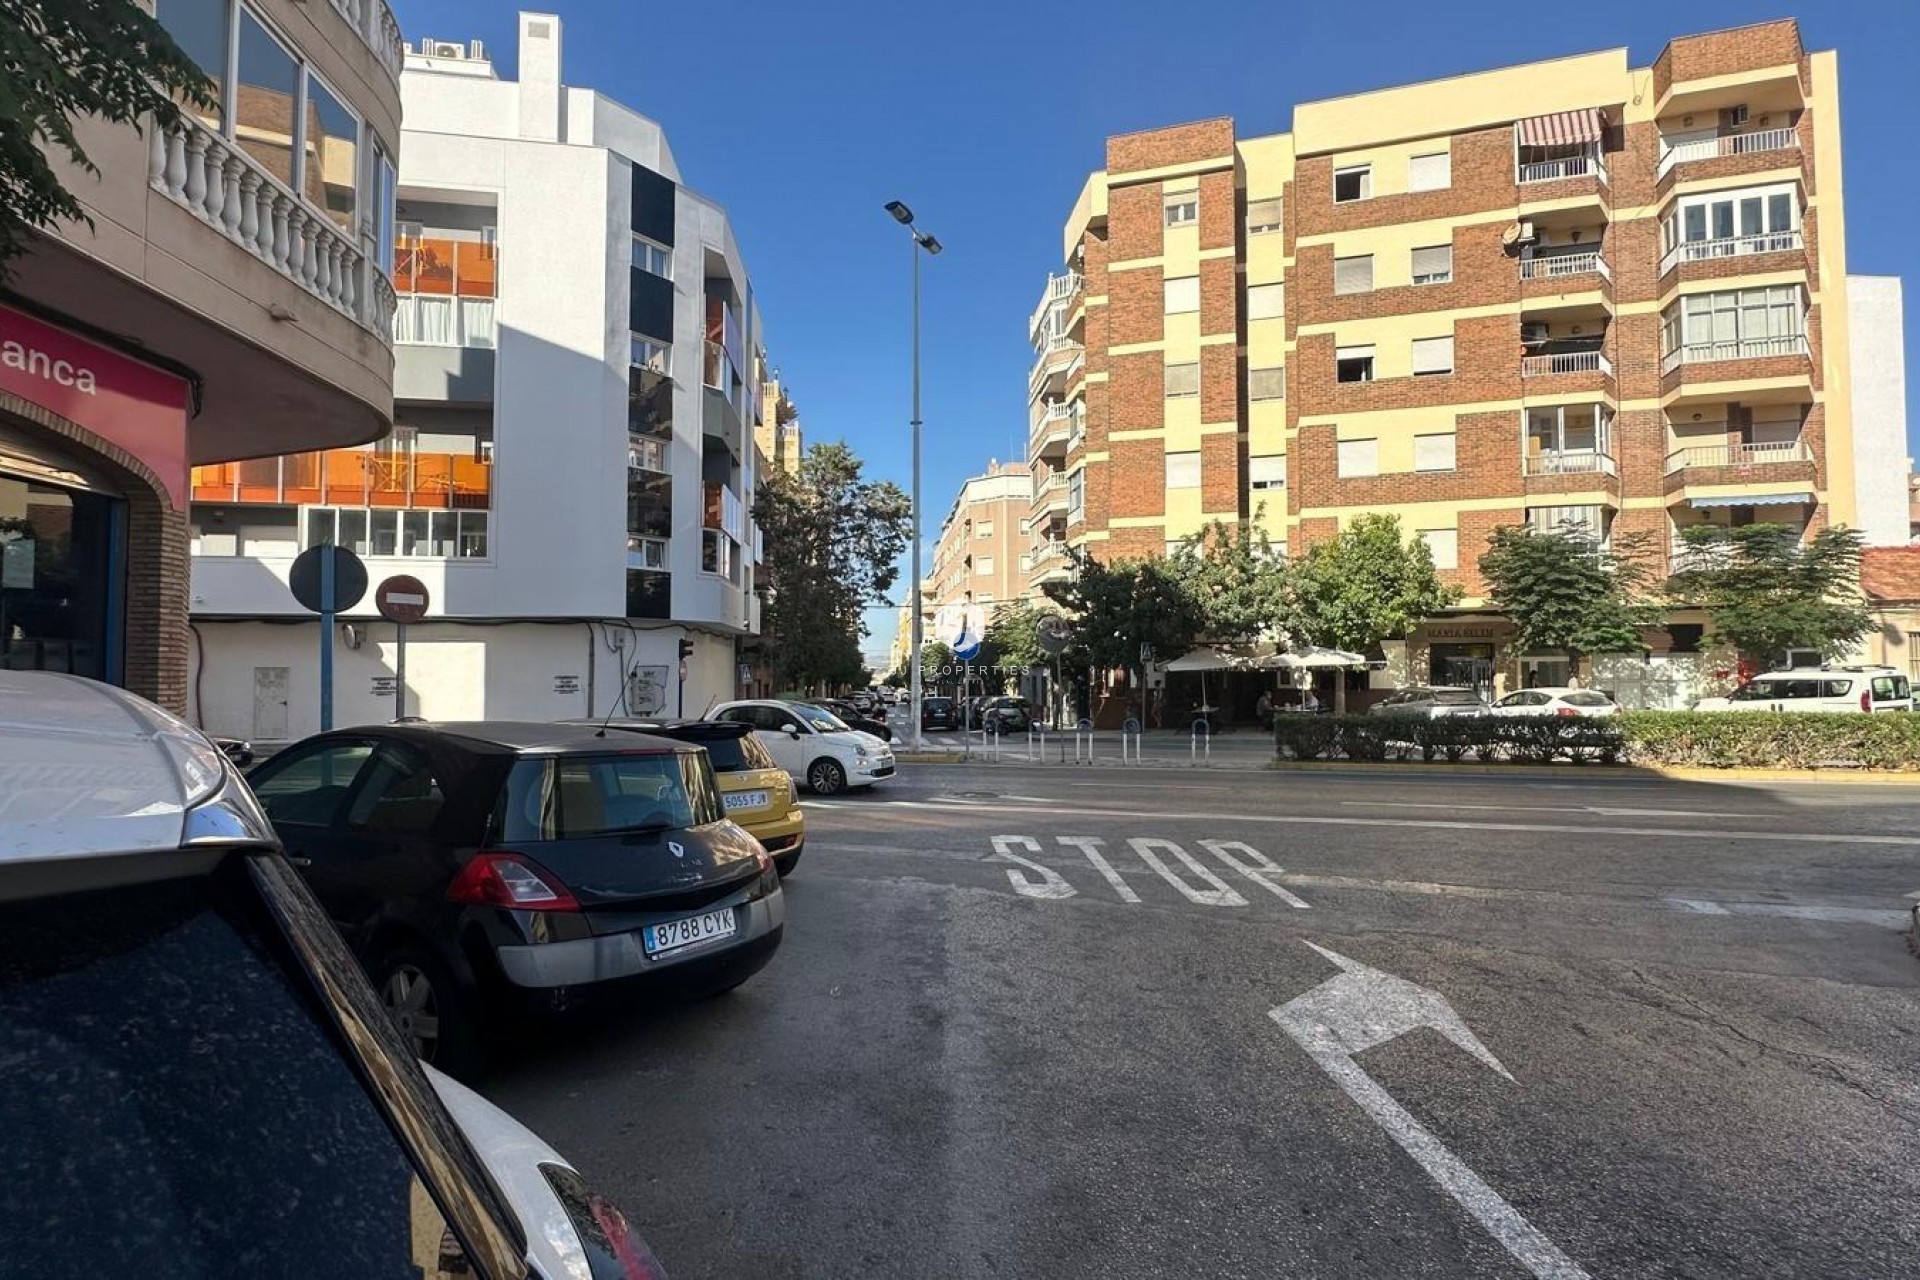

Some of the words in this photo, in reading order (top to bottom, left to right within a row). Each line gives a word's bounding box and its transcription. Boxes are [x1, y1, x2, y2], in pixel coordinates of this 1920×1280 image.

[1, 340, 97, 396] anca
[989, 834, 1313, 909] STOP
[657, 918, 700, 946] 8788
[703, 909, 733, 934] CYK
